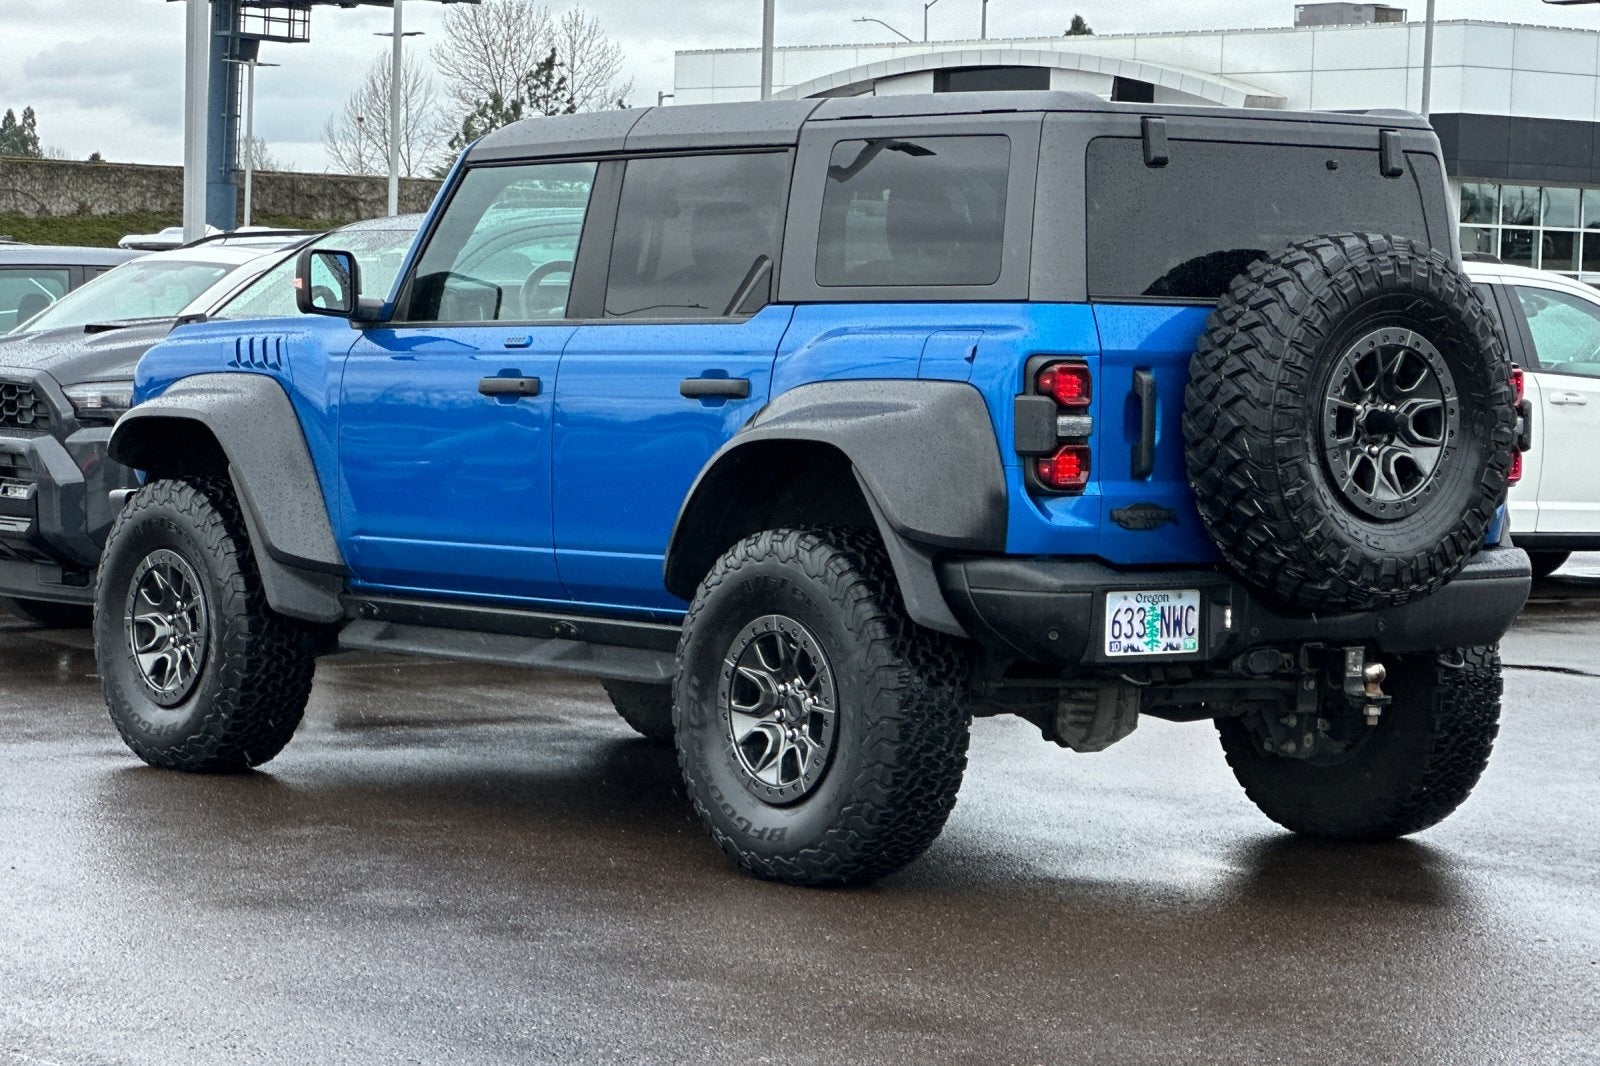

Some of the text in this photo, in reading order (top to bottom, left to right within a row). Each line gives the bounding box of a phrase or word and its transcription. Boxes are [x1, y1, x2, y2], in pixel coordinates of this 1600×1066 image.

[1136, 593, 1169, 605] Oregon
[1111, 605, 1195, 639] 633 NWC
